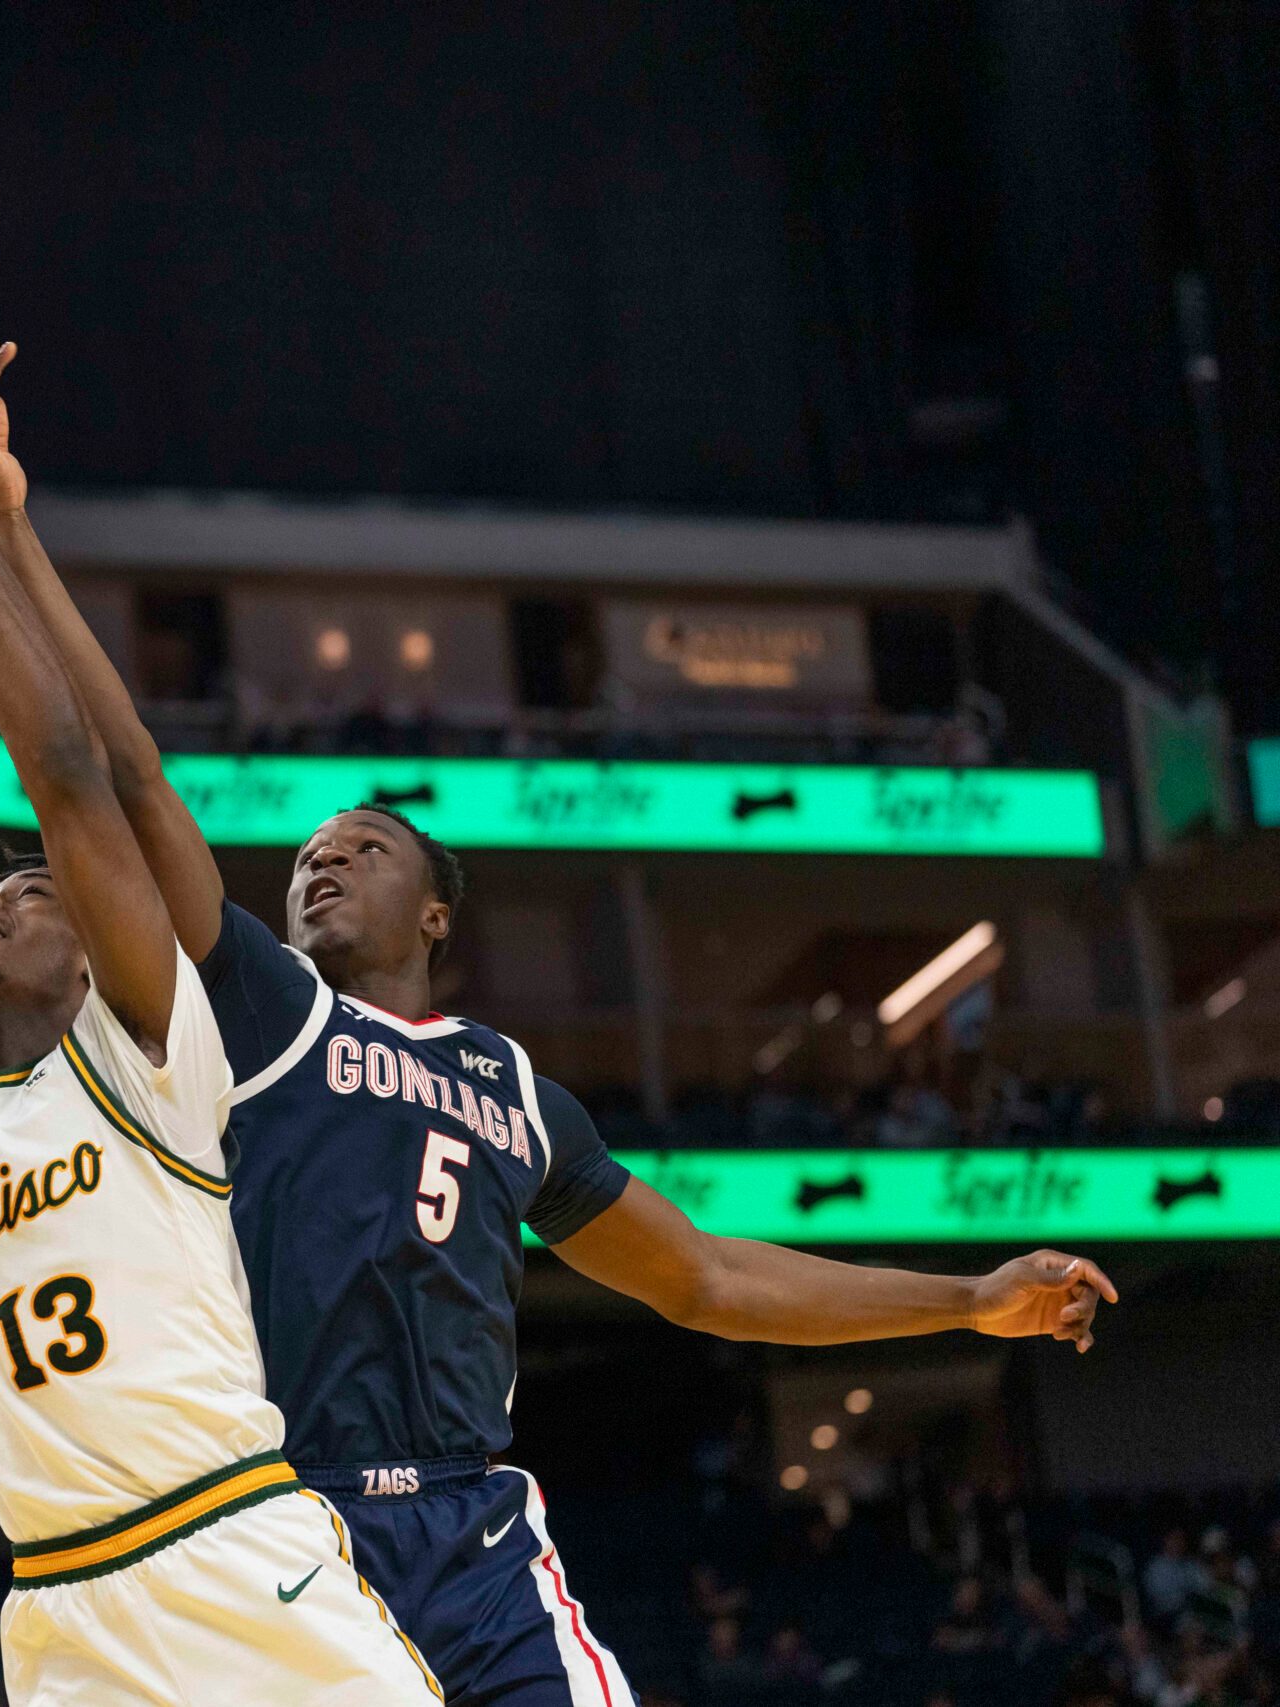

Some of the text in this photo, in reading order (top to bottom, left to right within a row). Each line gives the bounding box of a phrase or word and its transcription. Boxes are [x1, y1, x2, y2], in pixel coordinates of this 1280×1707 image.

[326, 1034, 532, 1169] GONZAGA
[459, 1049, 503, 1081] WCC
[416, 1128, 471, 1244] 5
[362, 1466, 420, 1496] ZAGS
